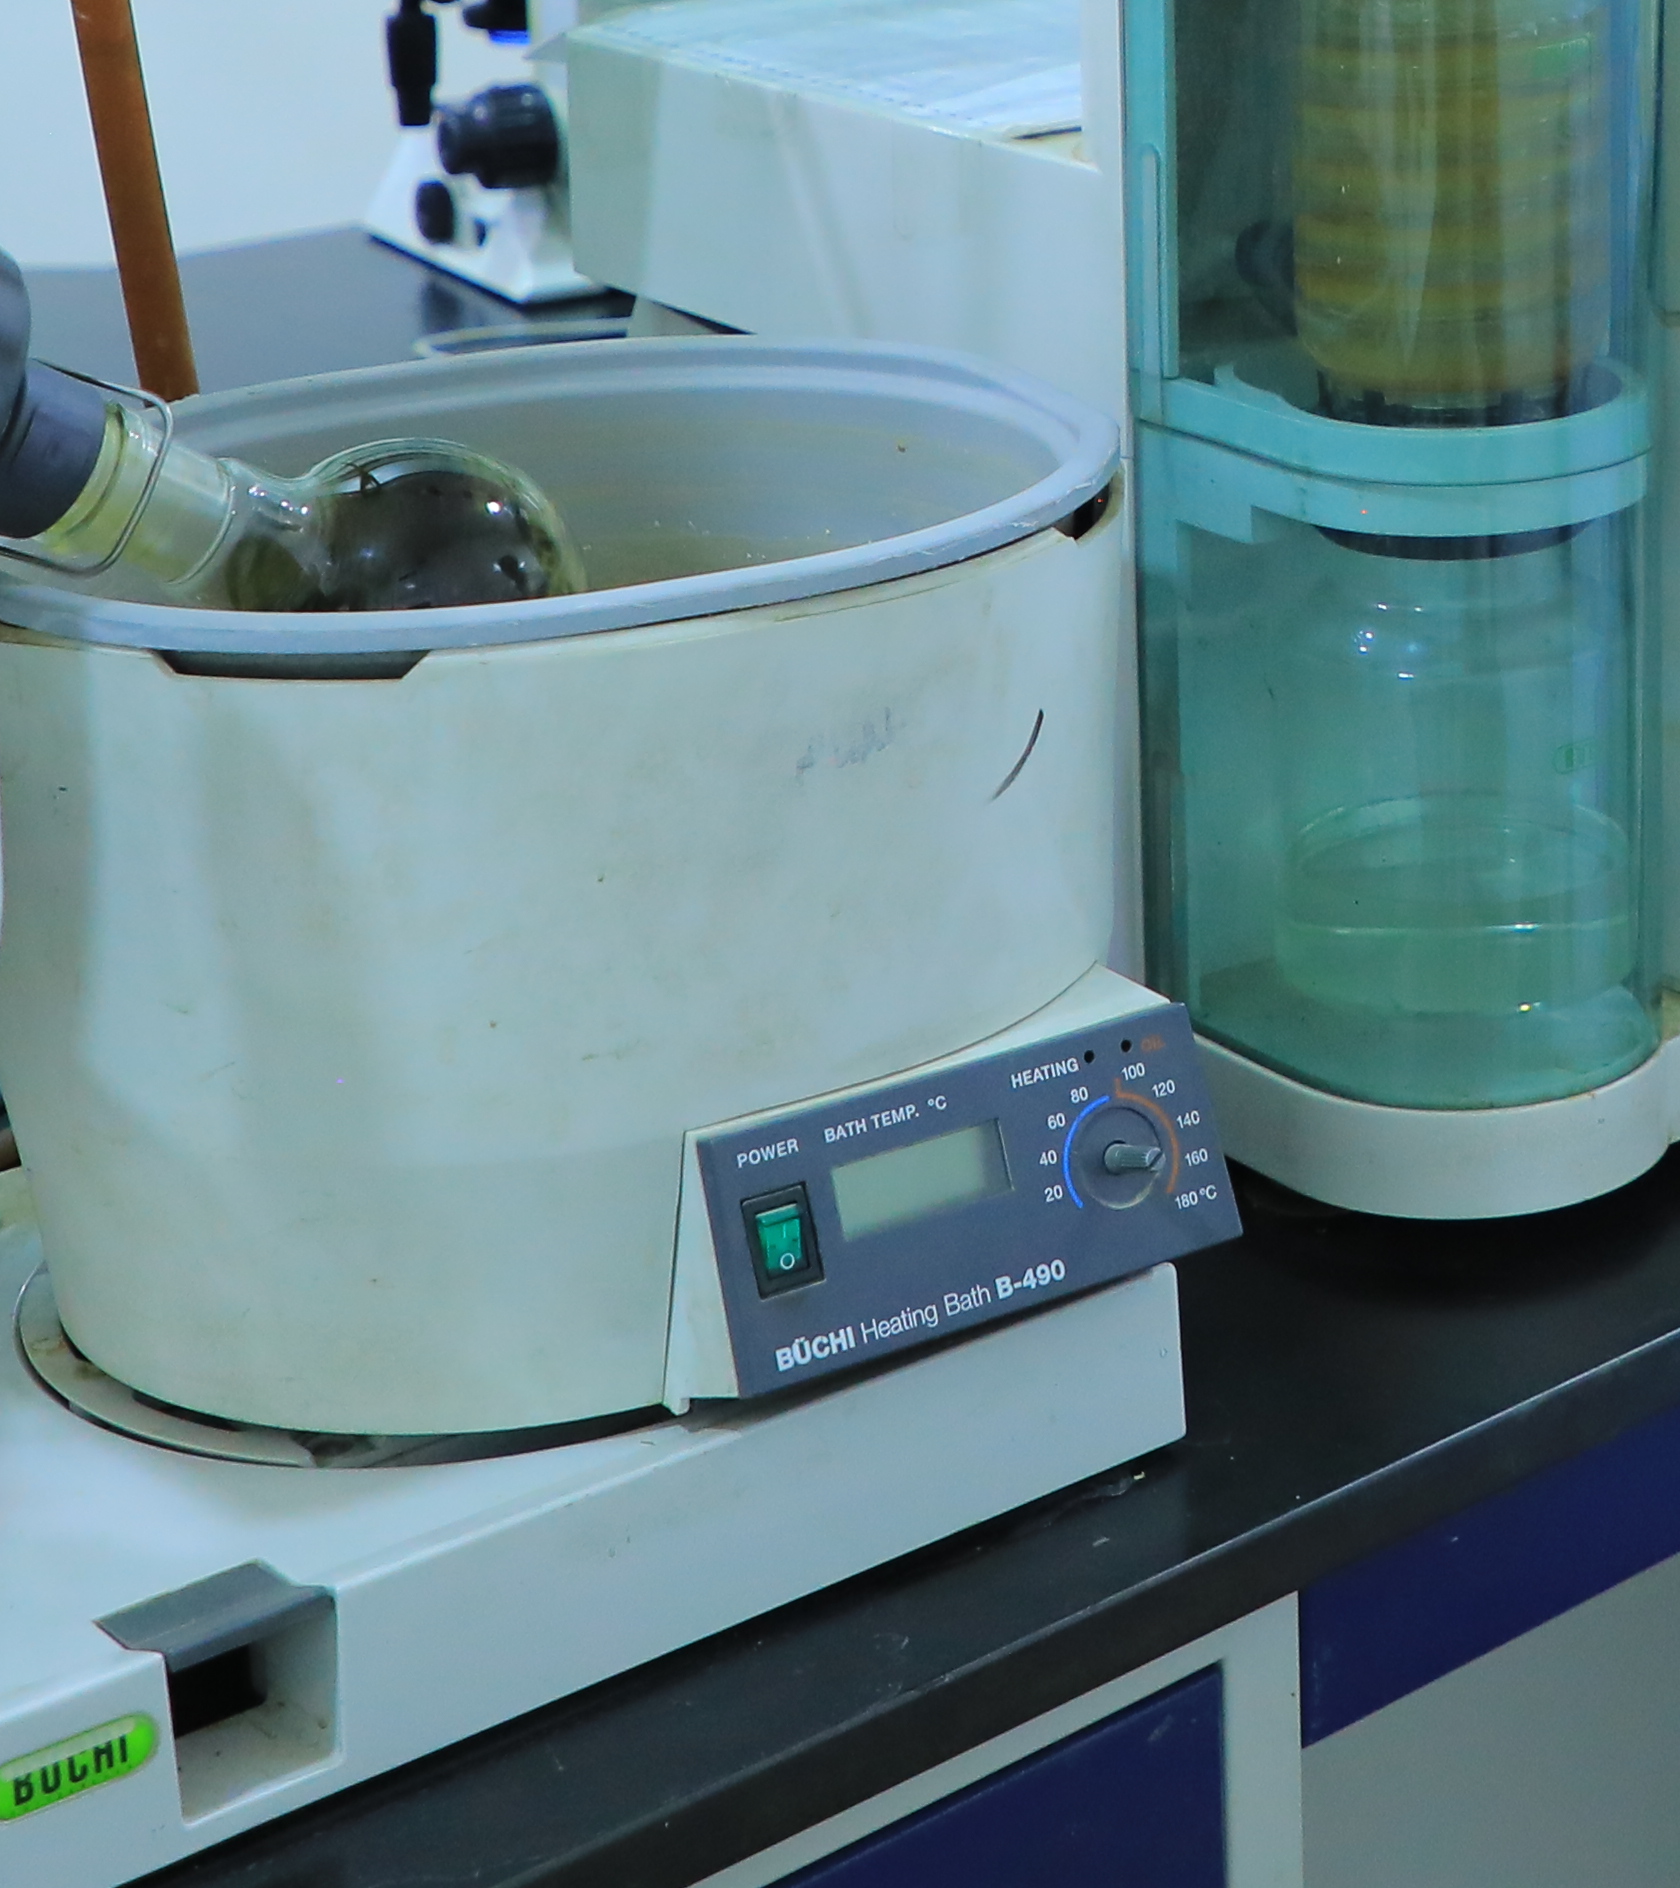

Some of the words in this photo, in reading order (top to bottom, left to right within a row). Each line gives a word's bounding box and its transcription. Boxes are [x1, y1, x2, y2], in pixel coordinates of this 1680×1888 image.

[1010, 1058, 1080, 1089] HEATING
[1122, 1062, 1146, 1081] 100
[1070, 1087, 1089, 1104] 80
[1152, 1079, 1176, 1098] 120
[824, 1117, 868, 1143] BATH
[871, 1104, 919, 1131] TEMP.
[1047, 1113, 1066, 1130] 60
[1176, 1110, 1201, 1129] 140
[736, 1138, 800, 1168] POWER
[1039, 1150, 1058, 1167] 40
[1184, 1148, 1209, 1167] 160
[1044, 1184, 1064, 1203] 20
[775, 1326, 857, 1372] BÜCHI
[860, 1301, 939, 1345] Heating
[945, 1285, 991, 1318] Bath
[994, 1259, 1066, 1300] B-490
